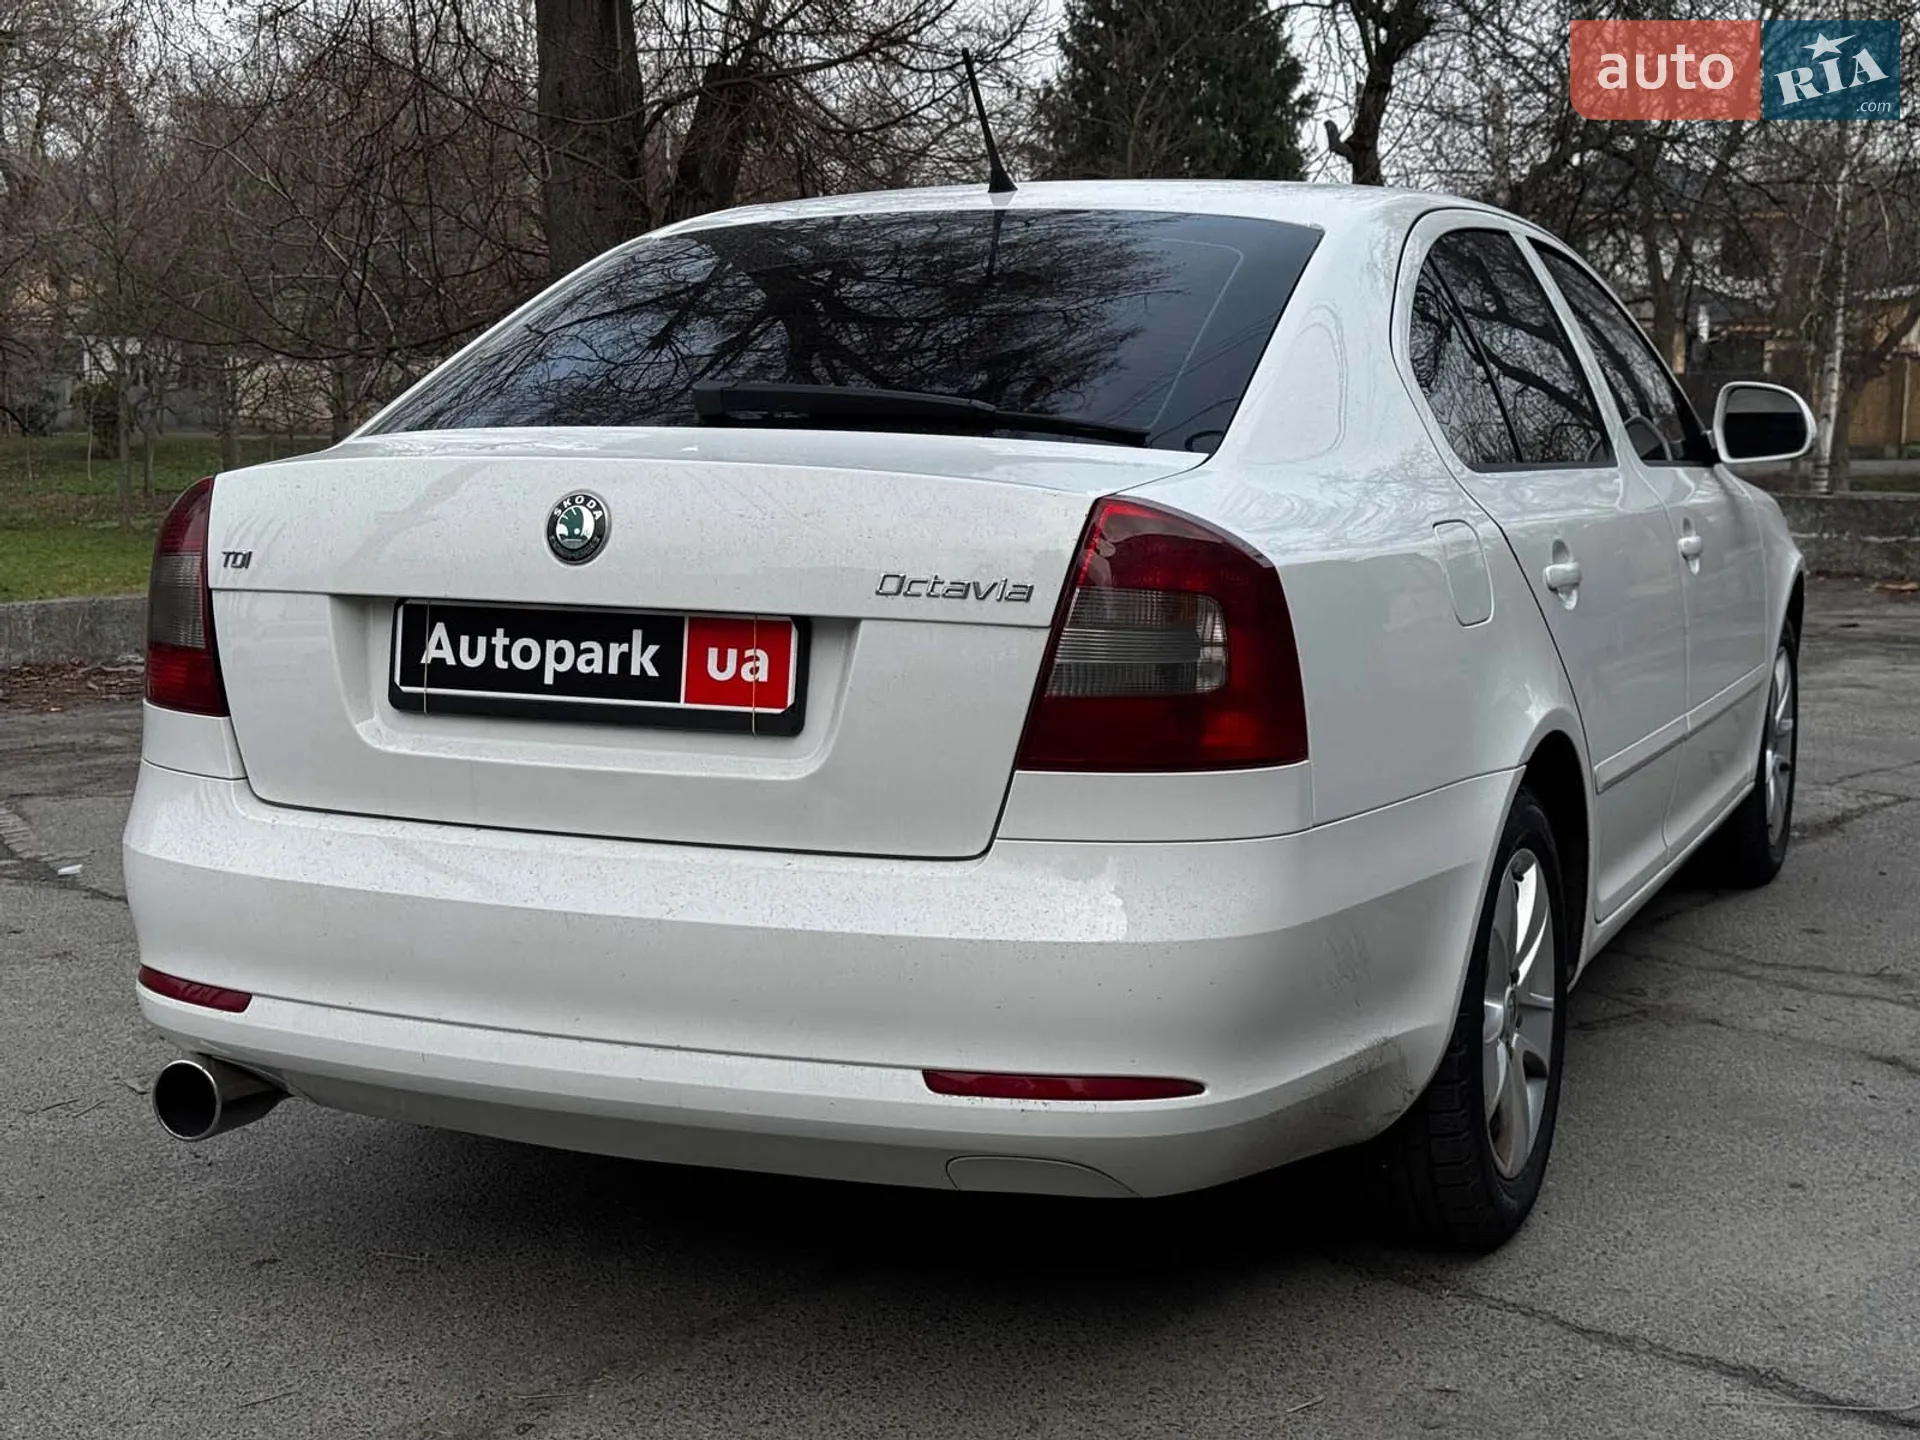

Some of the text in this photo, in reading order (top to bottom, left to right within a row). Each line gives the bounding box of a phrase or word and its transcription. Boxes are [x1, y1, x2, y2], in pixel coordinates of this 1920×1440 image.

[221, 550, 252, 570] TDI
[875, 573, 1035, 603] Octavia
[421, 621, 769, 685] Autopark ua
